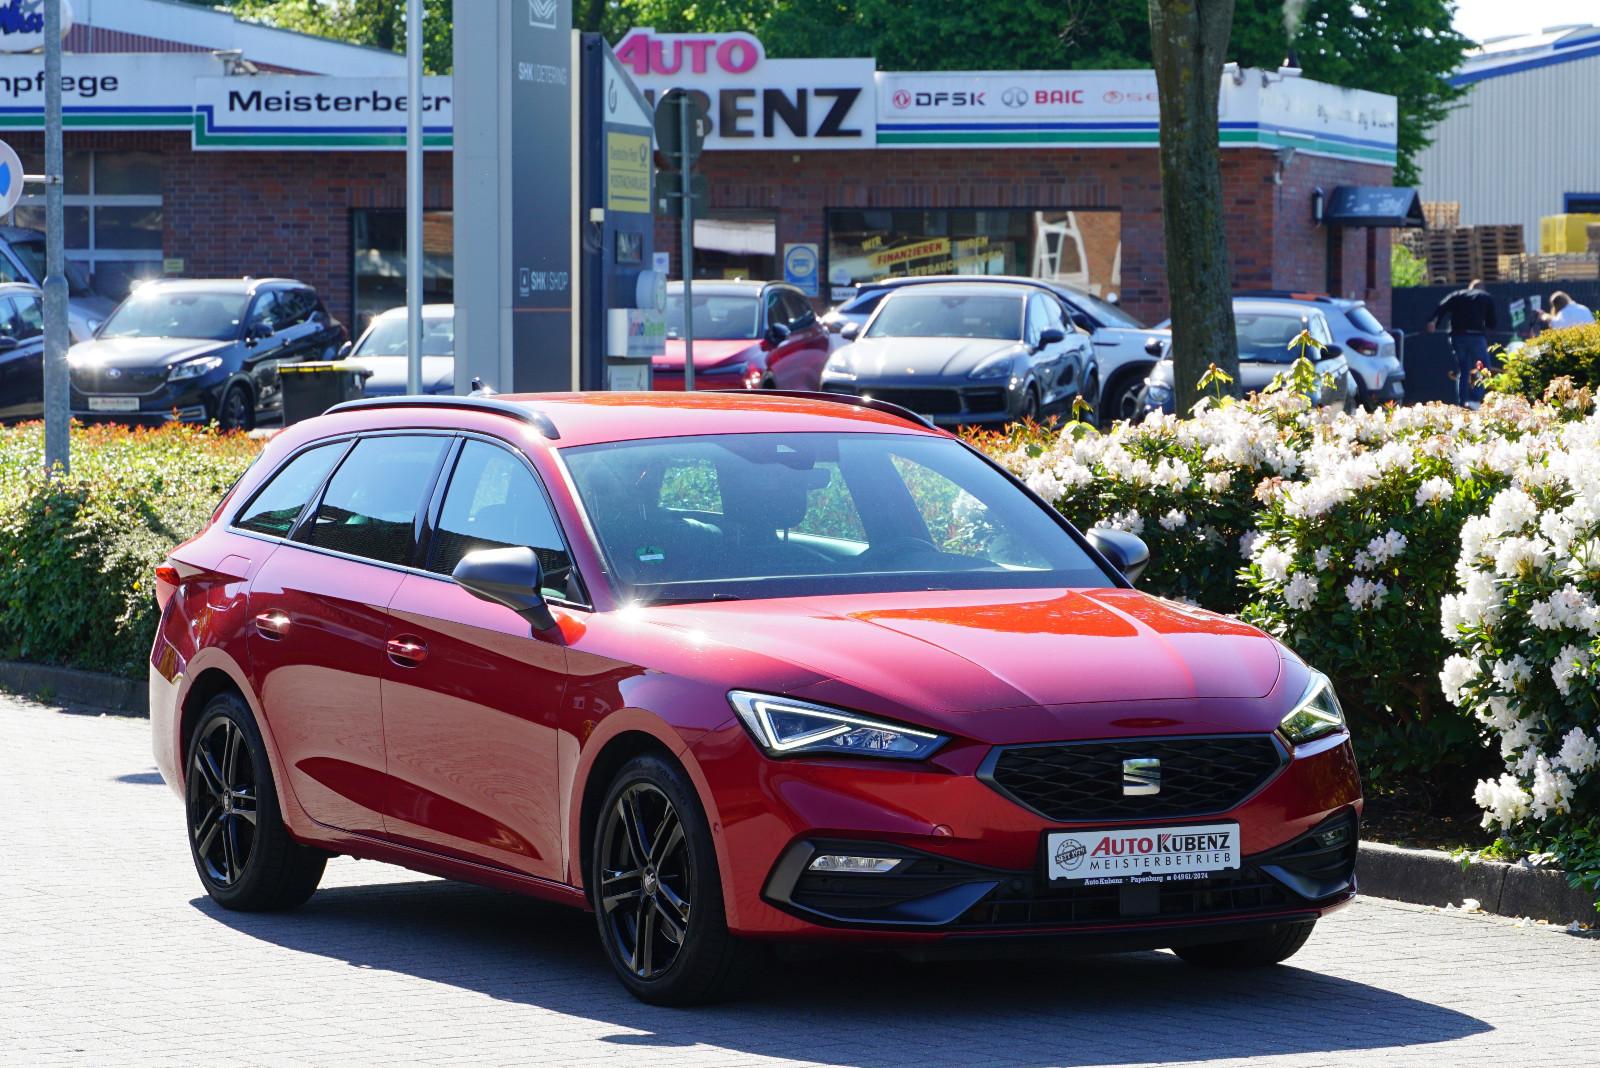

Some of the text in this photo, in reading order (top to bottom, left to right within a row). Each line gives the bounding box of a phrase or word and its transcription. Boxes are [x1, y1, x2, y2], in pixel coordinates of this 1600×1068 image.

[616, 34, 758, 75] AUTO
[518, 62, 534, 81] SHK
[0, 70, 118, 98] npfege
[915, 92, 987, 107] DFSK
[1035, 90, 1084, 105] BAIC
[861, 236, 882, 251] WIR
[876, 241, 943, 265] FINANZIEREN
[531, 271, 568, 292] SHK SHOP
[1090, 836, 1154, 857] AUTO
[1157, 833, 1231, 854] KUBENZ
[1089, 853, 1231, 871] MEISTERBETRIEB
[1130, 875, 1164, 884] Papenburg
